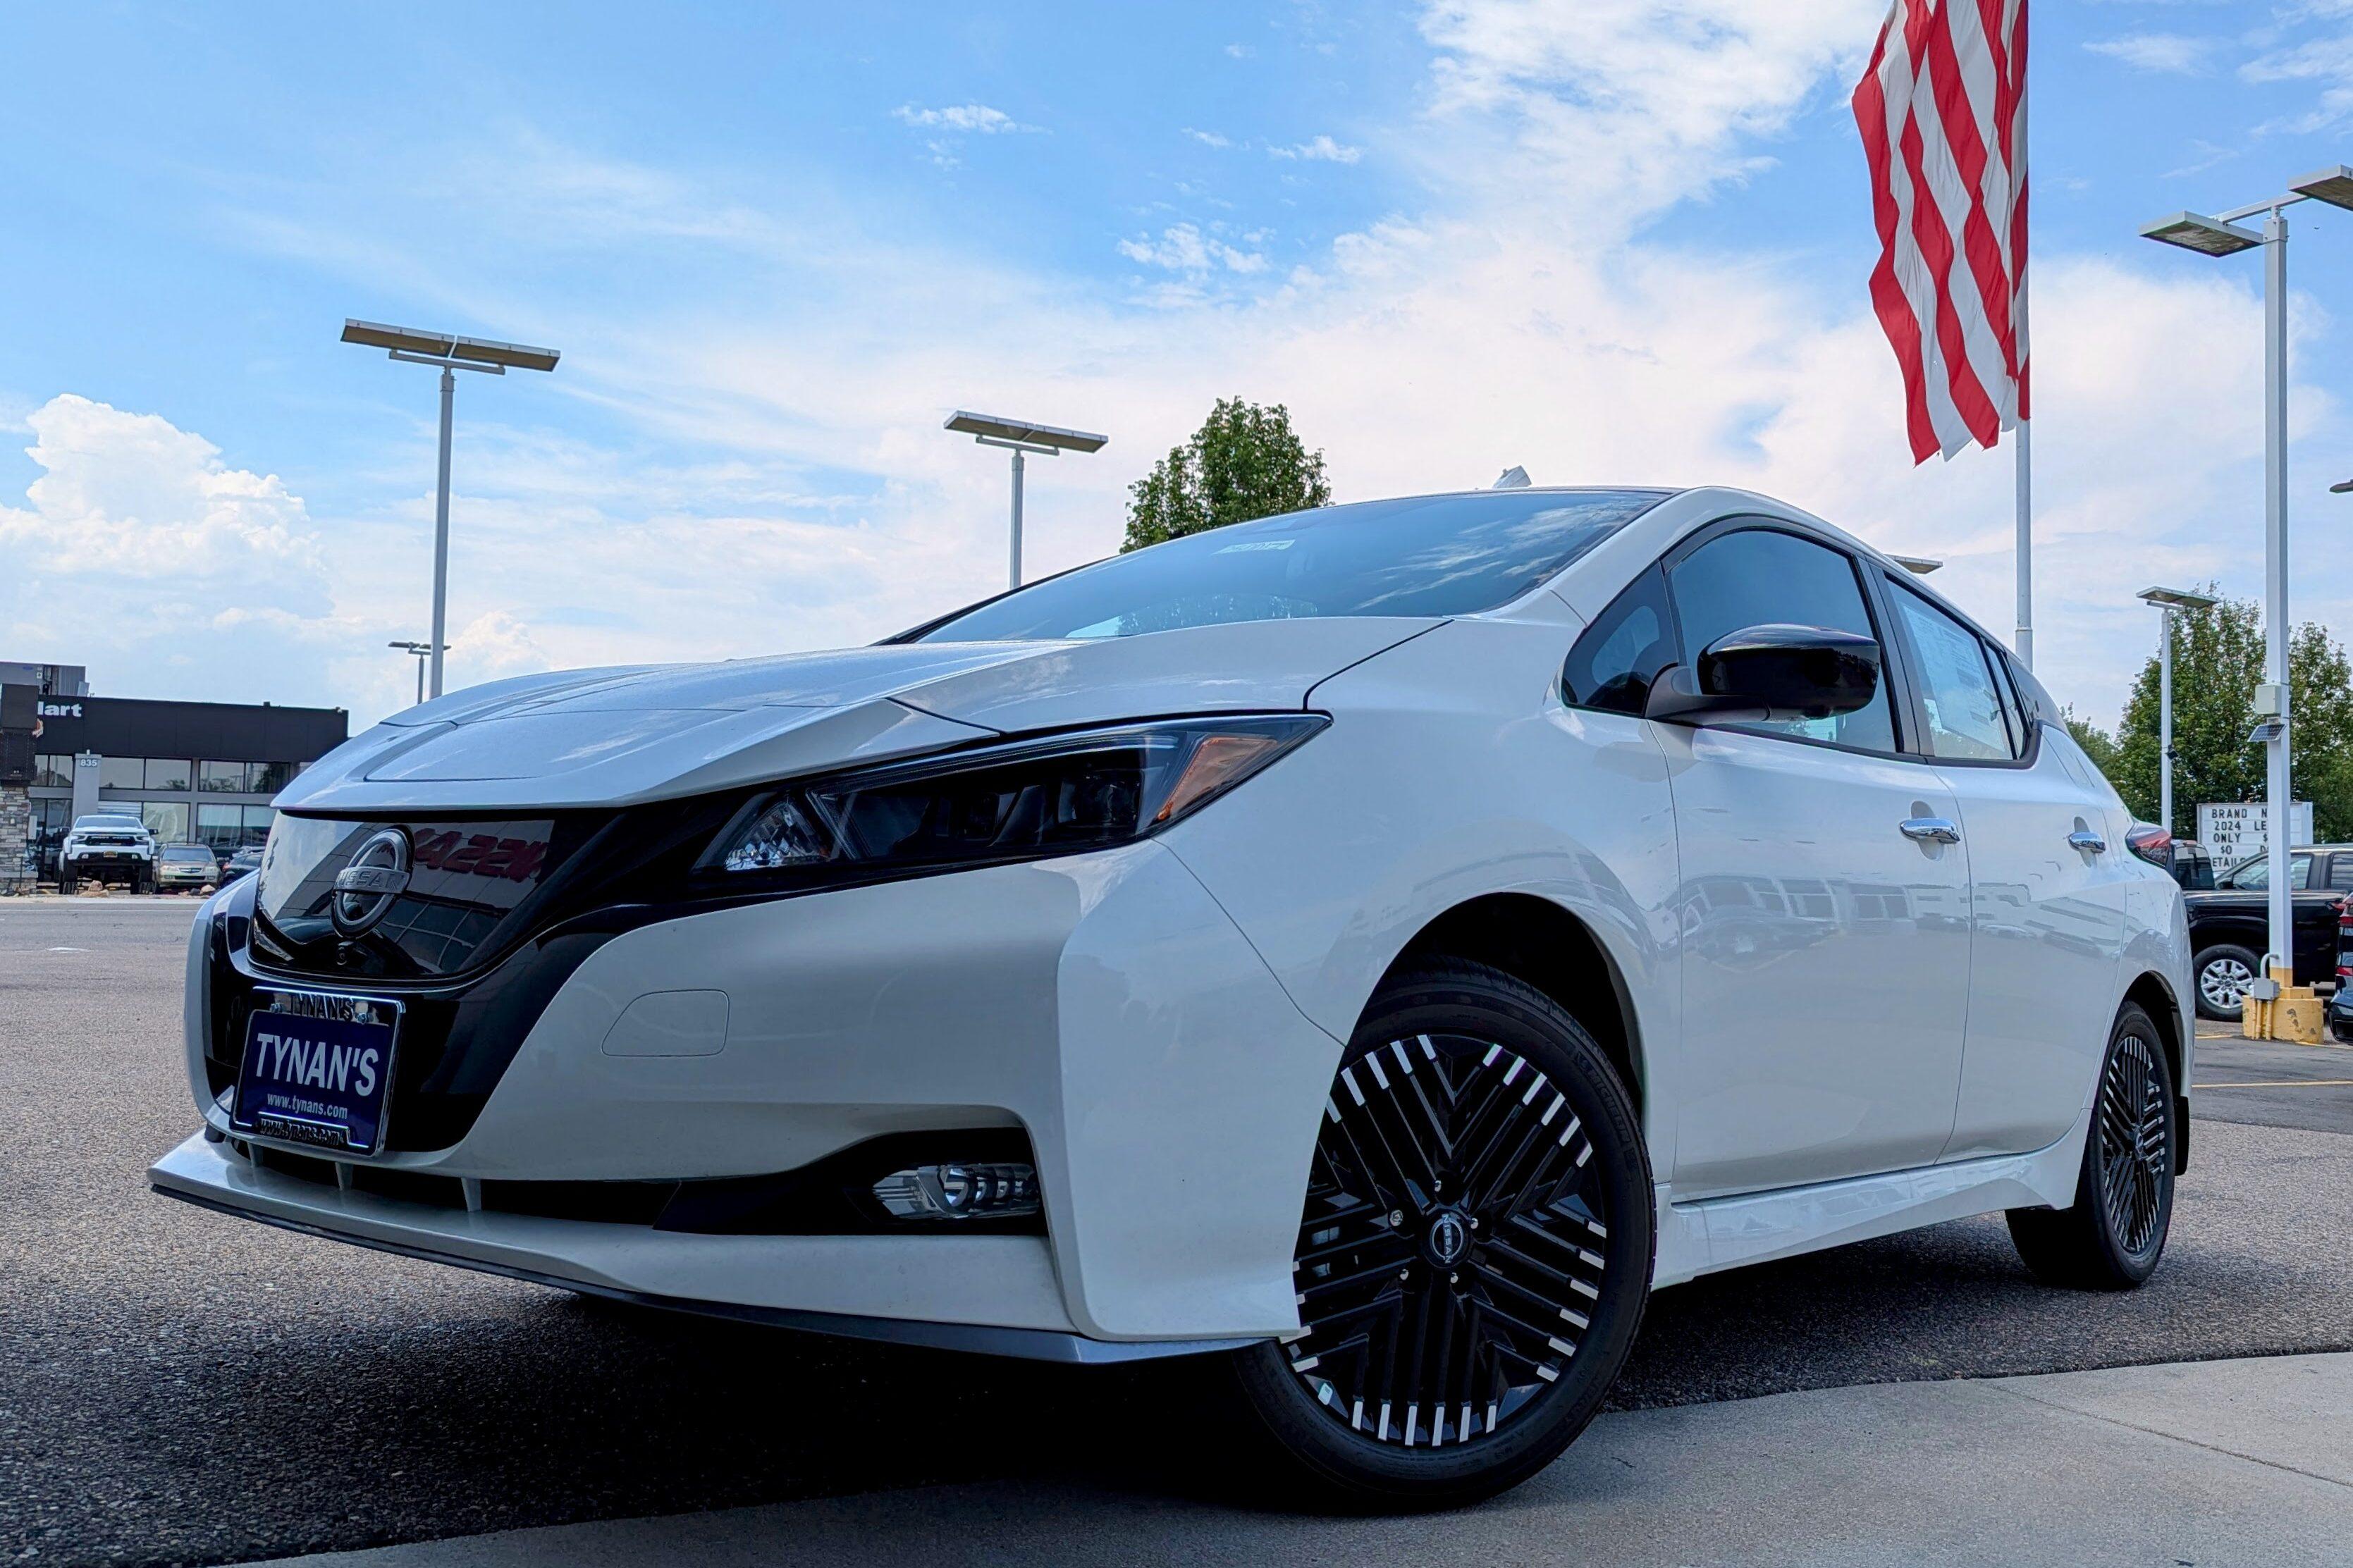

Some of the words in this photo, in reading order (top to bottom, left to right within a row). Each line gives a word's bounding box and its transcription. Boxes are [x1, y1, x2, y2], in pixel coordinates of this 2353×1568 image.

[80, 758, 98, 767] 835
[2212, 808, 2247, 818] BRAND
[2214, 821, 2241, 831] 2024
[2213, 833, 2241, 843] ONLY
[2220, 845, 2232, 855] $0
[333, 870, 407, 890] NISSAN
[255, 1032, 379, 1097] TYNAN'S
[266, 1093, 348, 1120] www.tynans.com
[1441, 1214, 1452, 1264] NISSAN
